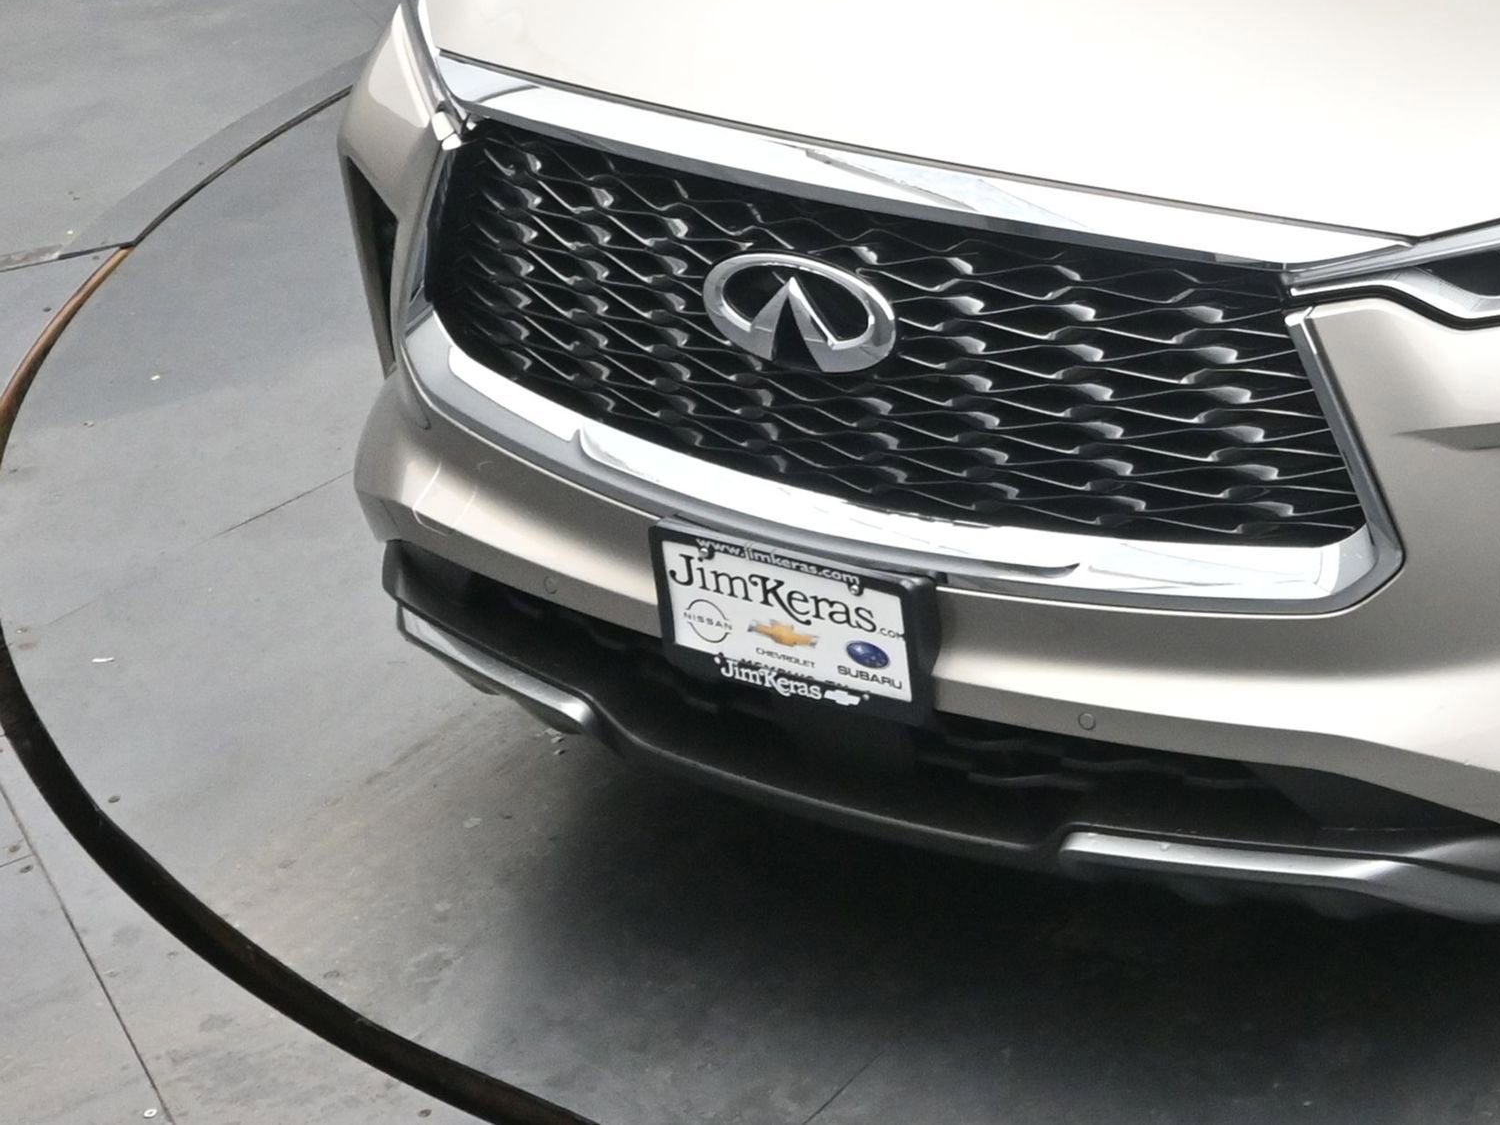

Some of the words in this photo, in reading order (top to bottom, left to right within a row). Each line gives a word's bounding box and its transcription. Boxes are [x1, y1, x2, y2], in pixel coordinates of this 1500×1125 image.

[696, 538, 860, 584] www.jimkeras.com
[683, 611, 733, 630] NISSAN
[755, 647, 816, 668] CHEVROLET
[837, 665, 903, 690] SUBARU
